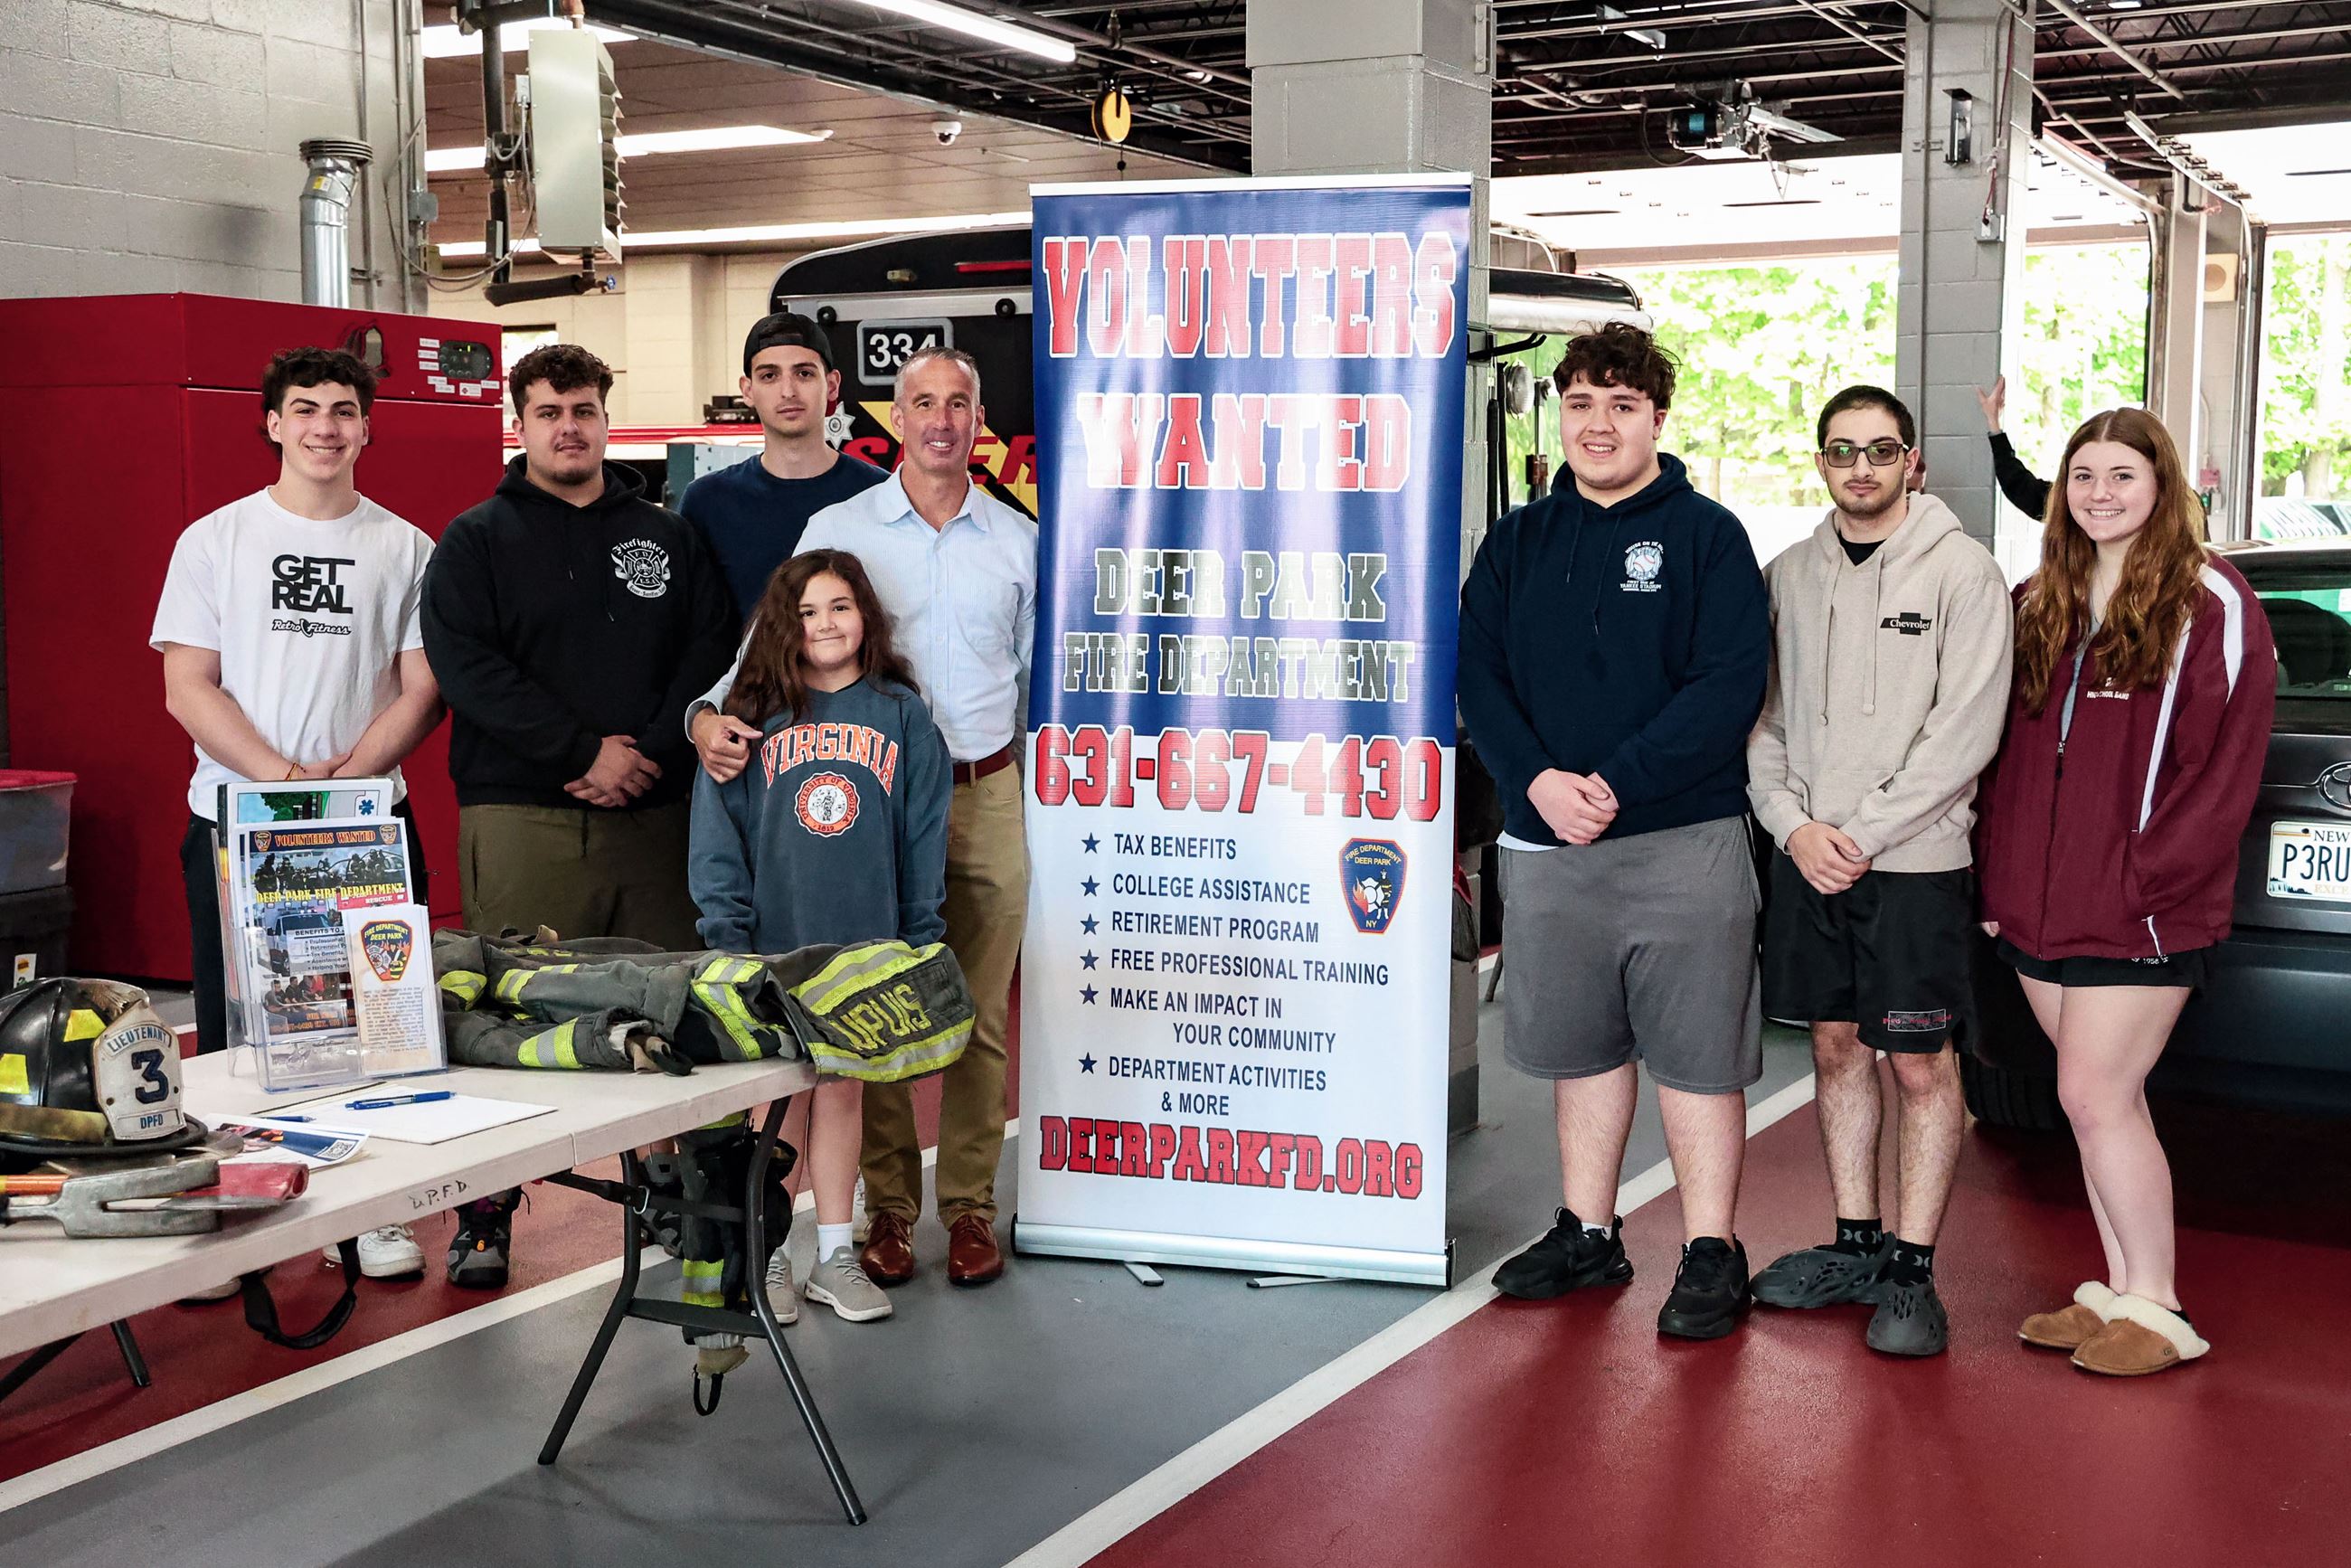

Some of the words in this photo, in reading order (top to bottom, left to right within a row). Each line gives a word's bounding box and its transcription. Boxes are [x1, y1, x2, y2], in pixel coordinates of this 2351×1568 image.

[1043, 233, 1456, 358] VOLUNTEERS
[1077, 392, 1412, 492] WANTED
[272, 554, 355, 586] GET
[1094, 548, 1226, 618] DEER
[1241, 551, 1388, 622] PARK
[272, 580, 353, 614] REAL
[272, 619, 304, 632] Retro
[307, 621, 351, 635] Fitness
[1890, 619, 1930, 629] Chevrolet
[1063, 631, 1149, 694] FIRE
[1158, 634, 1415, 703] DEPARTMENT
[760, 723, 899, 798] VIRGINIA
[1034, 723, 1443, 822] 631-667-4430
[799, 777, 827, 820] UNIVERSITY
[843, 783, 857, 823] VIRGINIA
[274, 832, 334, 847] VOLUNTEERS
[336, 830, 376, 845] WANTED
[1114, 834, 1145, 856] TAX
[1151, 836, 1237, 860] BENEFITS
[2314, 829, 2351, 843] NEW
[1345, 847, 1361, 862] FIRE
[1360, 844, 1402, 864] DEPARTMENT
[1355, 856, 1373, 864] DEER
[1374, 857, 1392, 865] PARK
[256, 891, 281, 903] DEER
[285, 889, 311, 902] PARK
[315, 888, 337, 900] FIRE
[340, 883, 404, 898] DEPARTMENT
[1112, 874, 1194, 898] COLLEGE
[1199, 878, 1310, 904] ASSISTANCE
[295, 928, 329, 936] BENEFITS
[370, 932, 386, 940] DEER
[1112, 911, 1223, 937] RETIREMENT
[1230, 917, 1319, 943] PROGRAM
[1365, 920, 1378, 928] NY
[1111, 949, 1155, 971] FREE
[1161, 951, 1298, 981] PROFESSIONAL
[1303, 959, 1389, 986] TRAINING
[1109, 987, 1158, 1010] MAKE
[1164, 991, 1187, 1012] AN
[1194, 993, 1259, 1018] IMPACT
[1265, 997, 1282, 1018] IN
[107, 1026, 167, 1053] LIEUTENANT
[1173, 1022, 1222, 1046] YOUR
[1228, 1025, 1336, 1053] COMMUNITY
[131, 1049, 169, 1104] 3
[1109, 1056, 1225, 1084] DEPARTMENT
[1229, 1063, 1327, 1091] ACTIVITIES
[1161, 1091, 1172, 1111] &
[1178, 1092, 1230, 1116] MORE
[1040, 1116, 1423, 1199] DEERPARKFD.ORG
